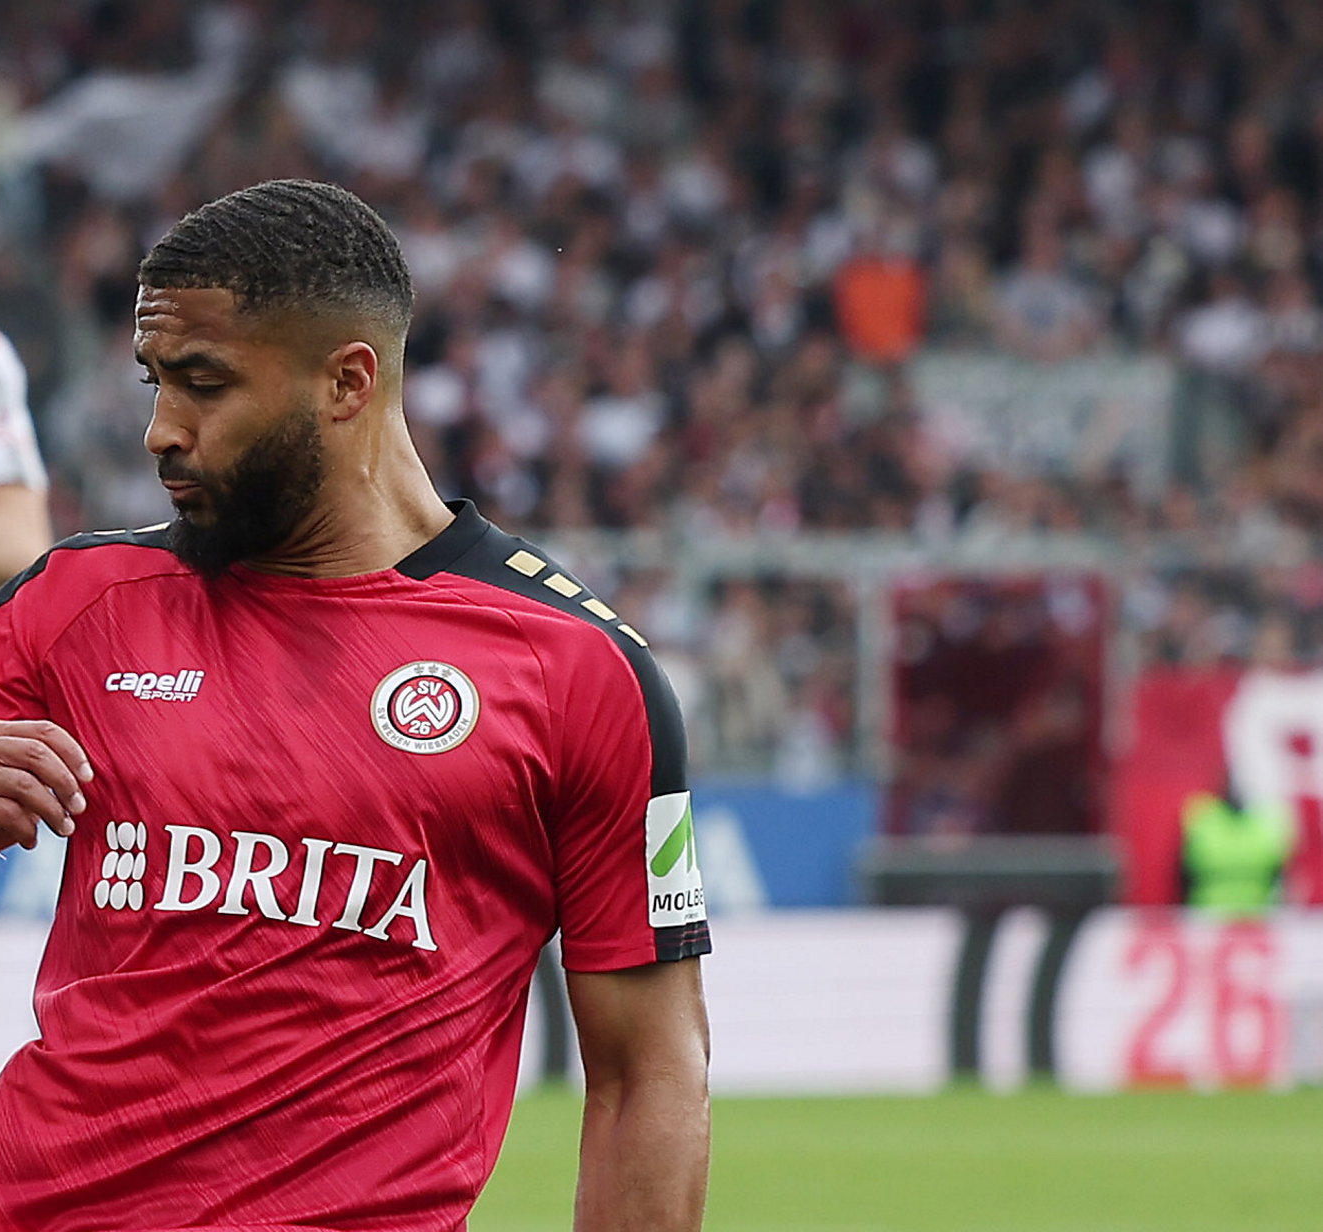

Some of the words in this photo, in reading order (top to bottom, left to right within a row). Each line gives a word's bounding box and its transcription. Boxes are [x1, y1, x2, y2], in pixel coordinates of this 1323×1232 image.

[105, 669, 205, 697] capelli
[417, 680, 442, 696] SV
[139, 690, 198, 702] SPORT
[381, 722, 411, 747] WEHEN
[408, 720, 431, 735] 26
[154, 824, 438, 951] BRITA
[1124, 915, 1283, 1090] 26
